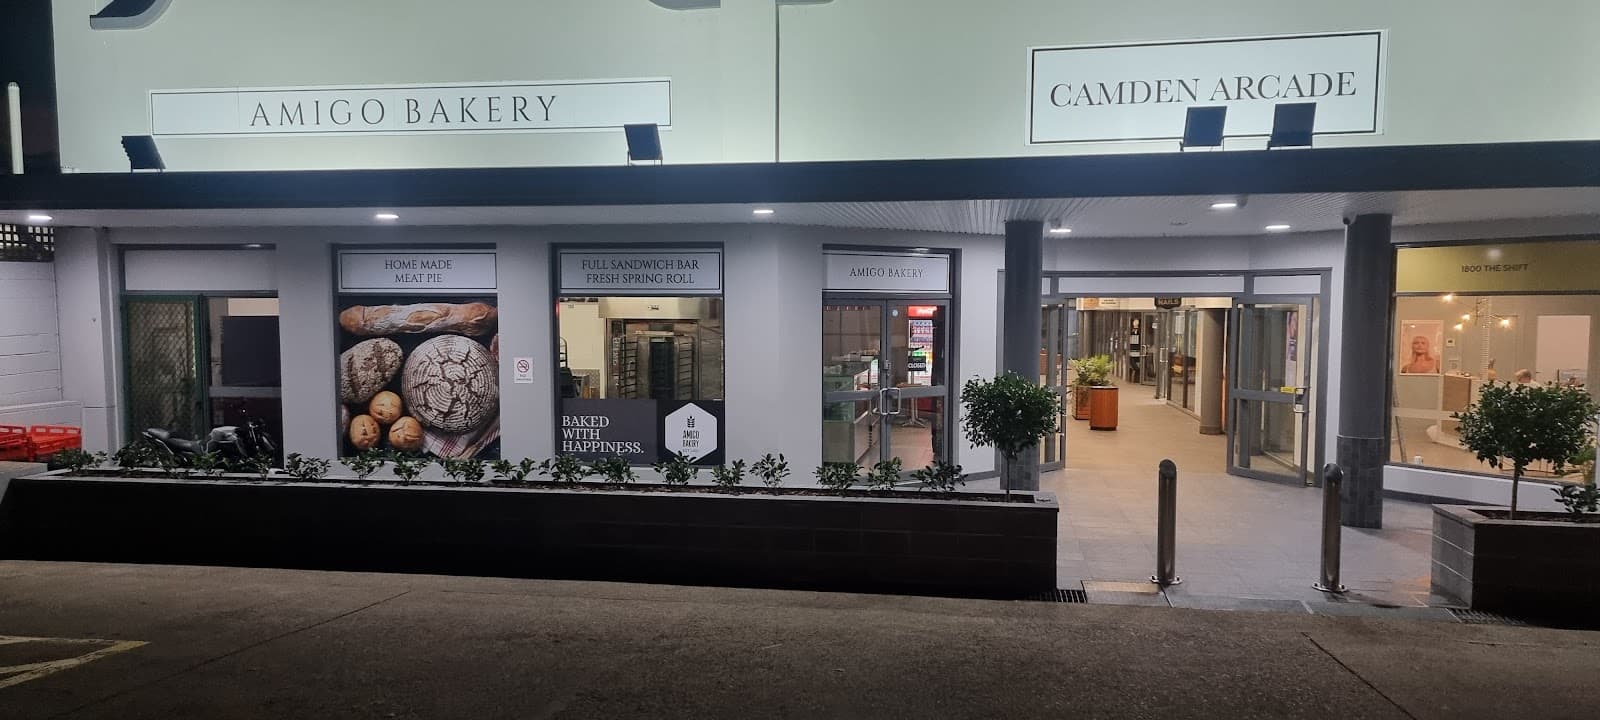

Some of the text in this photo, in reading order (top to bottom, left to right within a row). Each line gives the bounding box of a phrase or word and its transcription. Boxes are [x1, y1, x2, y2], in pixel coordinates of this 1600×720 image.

[1050, 71, 1357, 107] CAMDEN ARCADE
[250, 95, 557, 127] AMIGO BAKERY
[385, 259, 453, 270] HOME MADE
[582, 259, 700, 270] FULL SANDWICH BAR
[1461, 263, 1528, 273] 1800 THE SHIFT
[395, 273, 443, 283] MEAT PIE
[849, 267, 923, 278] AMIGO BAKERY
[586, 273, 694, 284] FRESH SPRING ROLL
[562, 415, 609, 428] BAKED
[562, 428, 601, 440] WITH
[682, 430, 700, 439] AMIGO
[562, 440, 645, 456] HAPPINESS.
[682, 439, 700, 447] BAKERY
